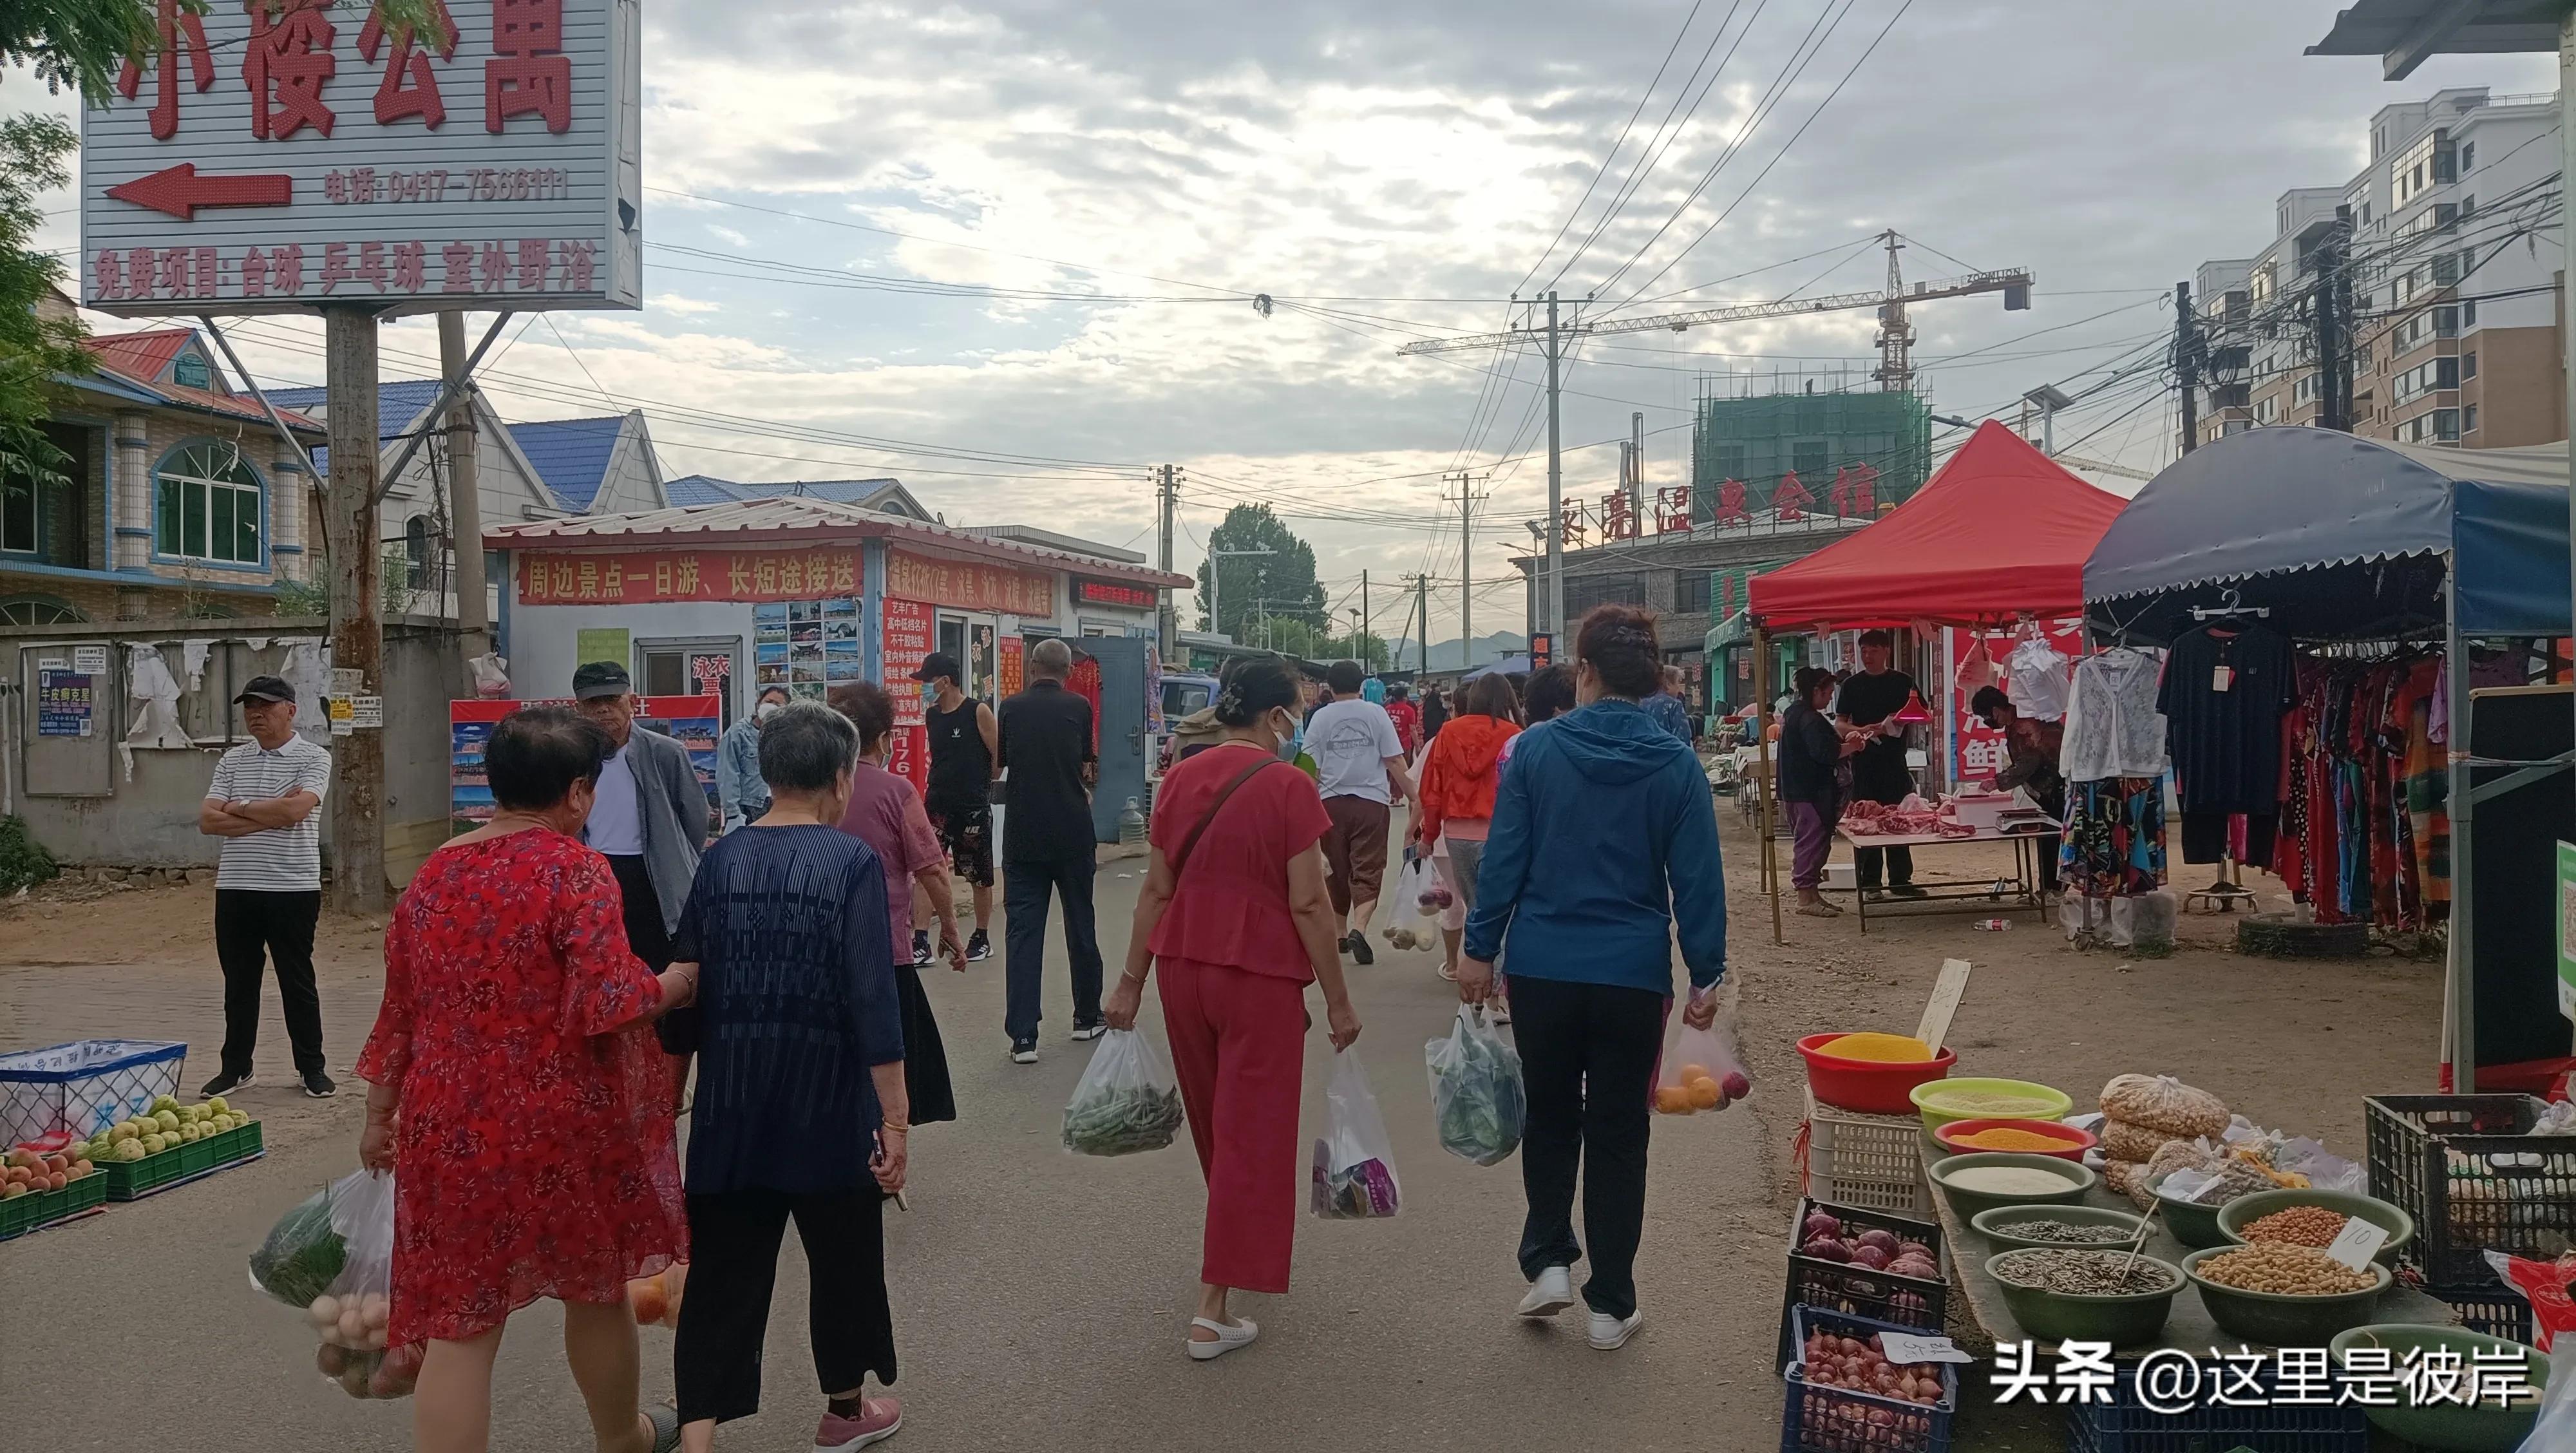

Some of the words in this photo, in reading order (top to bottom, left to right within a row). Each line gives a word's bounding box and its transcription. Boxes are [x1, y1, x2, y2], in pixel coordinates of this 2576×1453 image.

[324, 167, 569, 205] 电话:0417-7566111
[319, 241, 426, 295] 乒乓球
[442, 238, 596, 294] 室外野浴
[891, 600, 919, 615] 艺丰广告
[887, 616, 927, 632] 高中低档名片
[890, 634, 925, 648] 不干胶粘贴
[692, 656, 730, 679] 泳衣
[2342, 1226, 2371, 1245] 10
